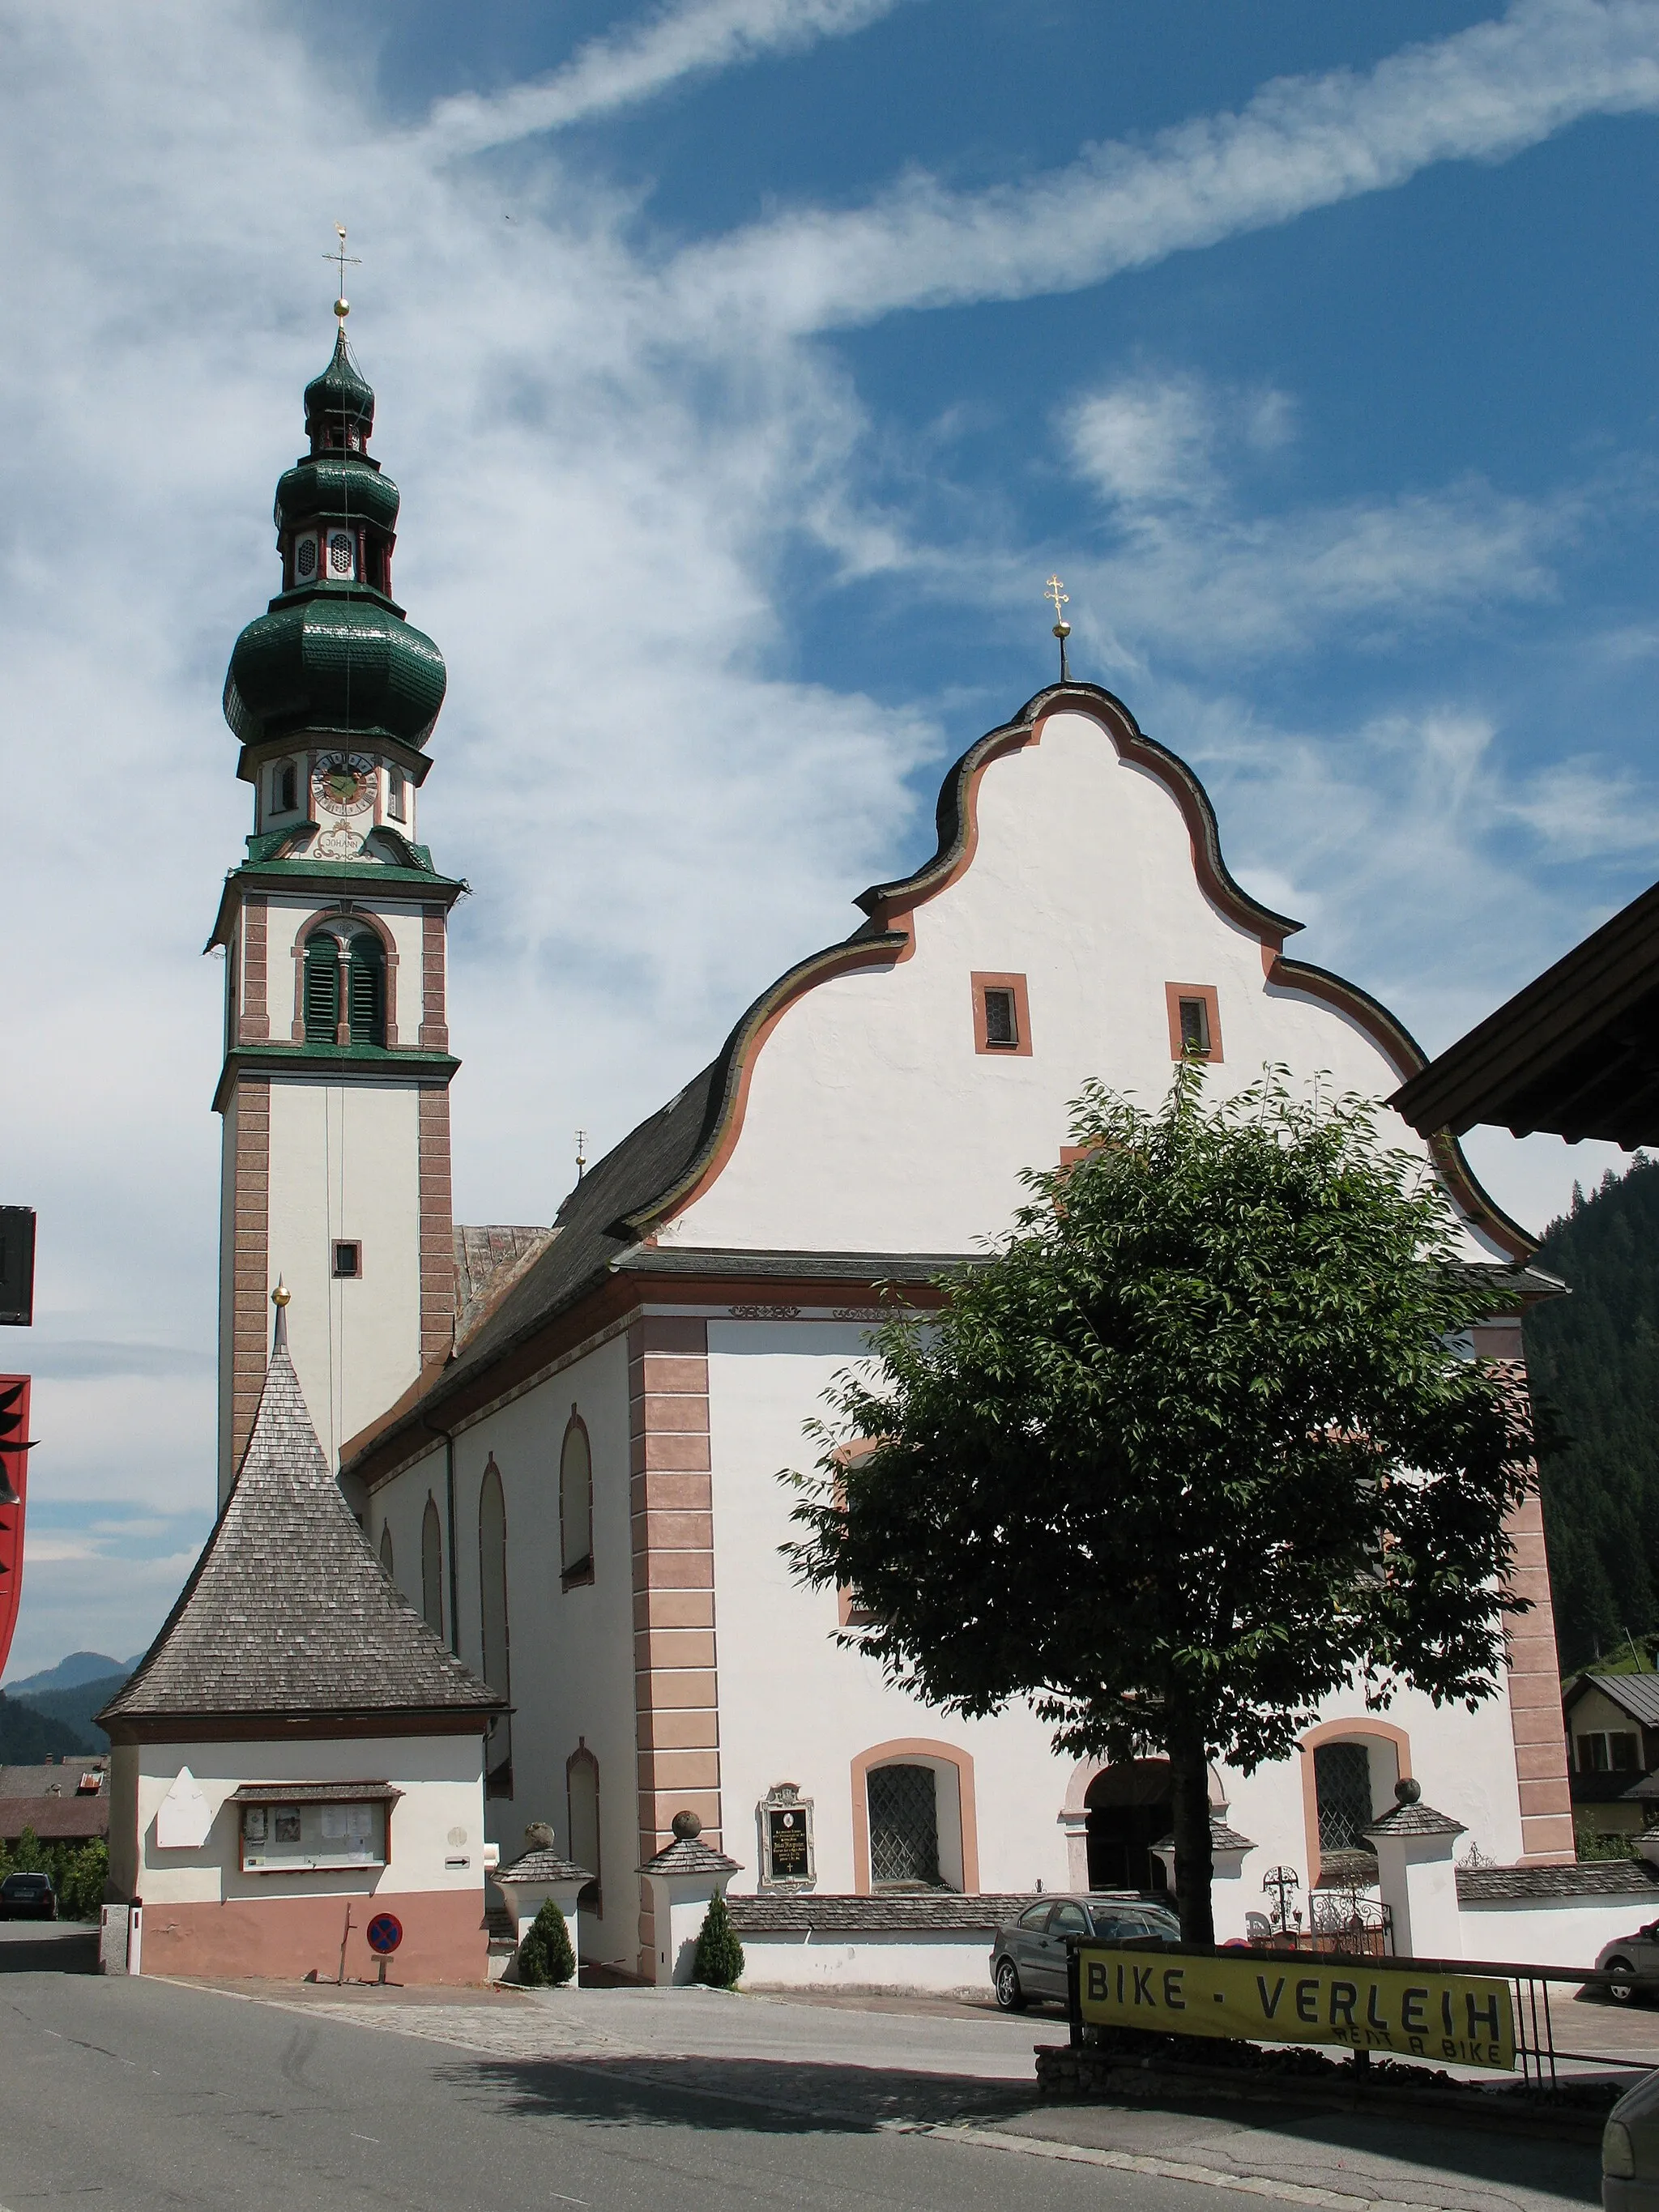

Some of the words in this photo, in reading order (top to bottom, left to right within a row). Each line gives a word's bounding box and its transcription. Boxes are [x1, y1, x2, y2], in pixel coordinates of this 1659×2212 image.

[326, 838, 358, 848] JOHANN
[1088, 1961, 1186, 2010] BIKE
[1256, 1975, 1500, 2041] VERLEIH
[1330, 2027, 1393, 2047] RENT
[1408, 2036, 1425, 2055] A
[1442, 2038, 1502, 2065] BIKE
